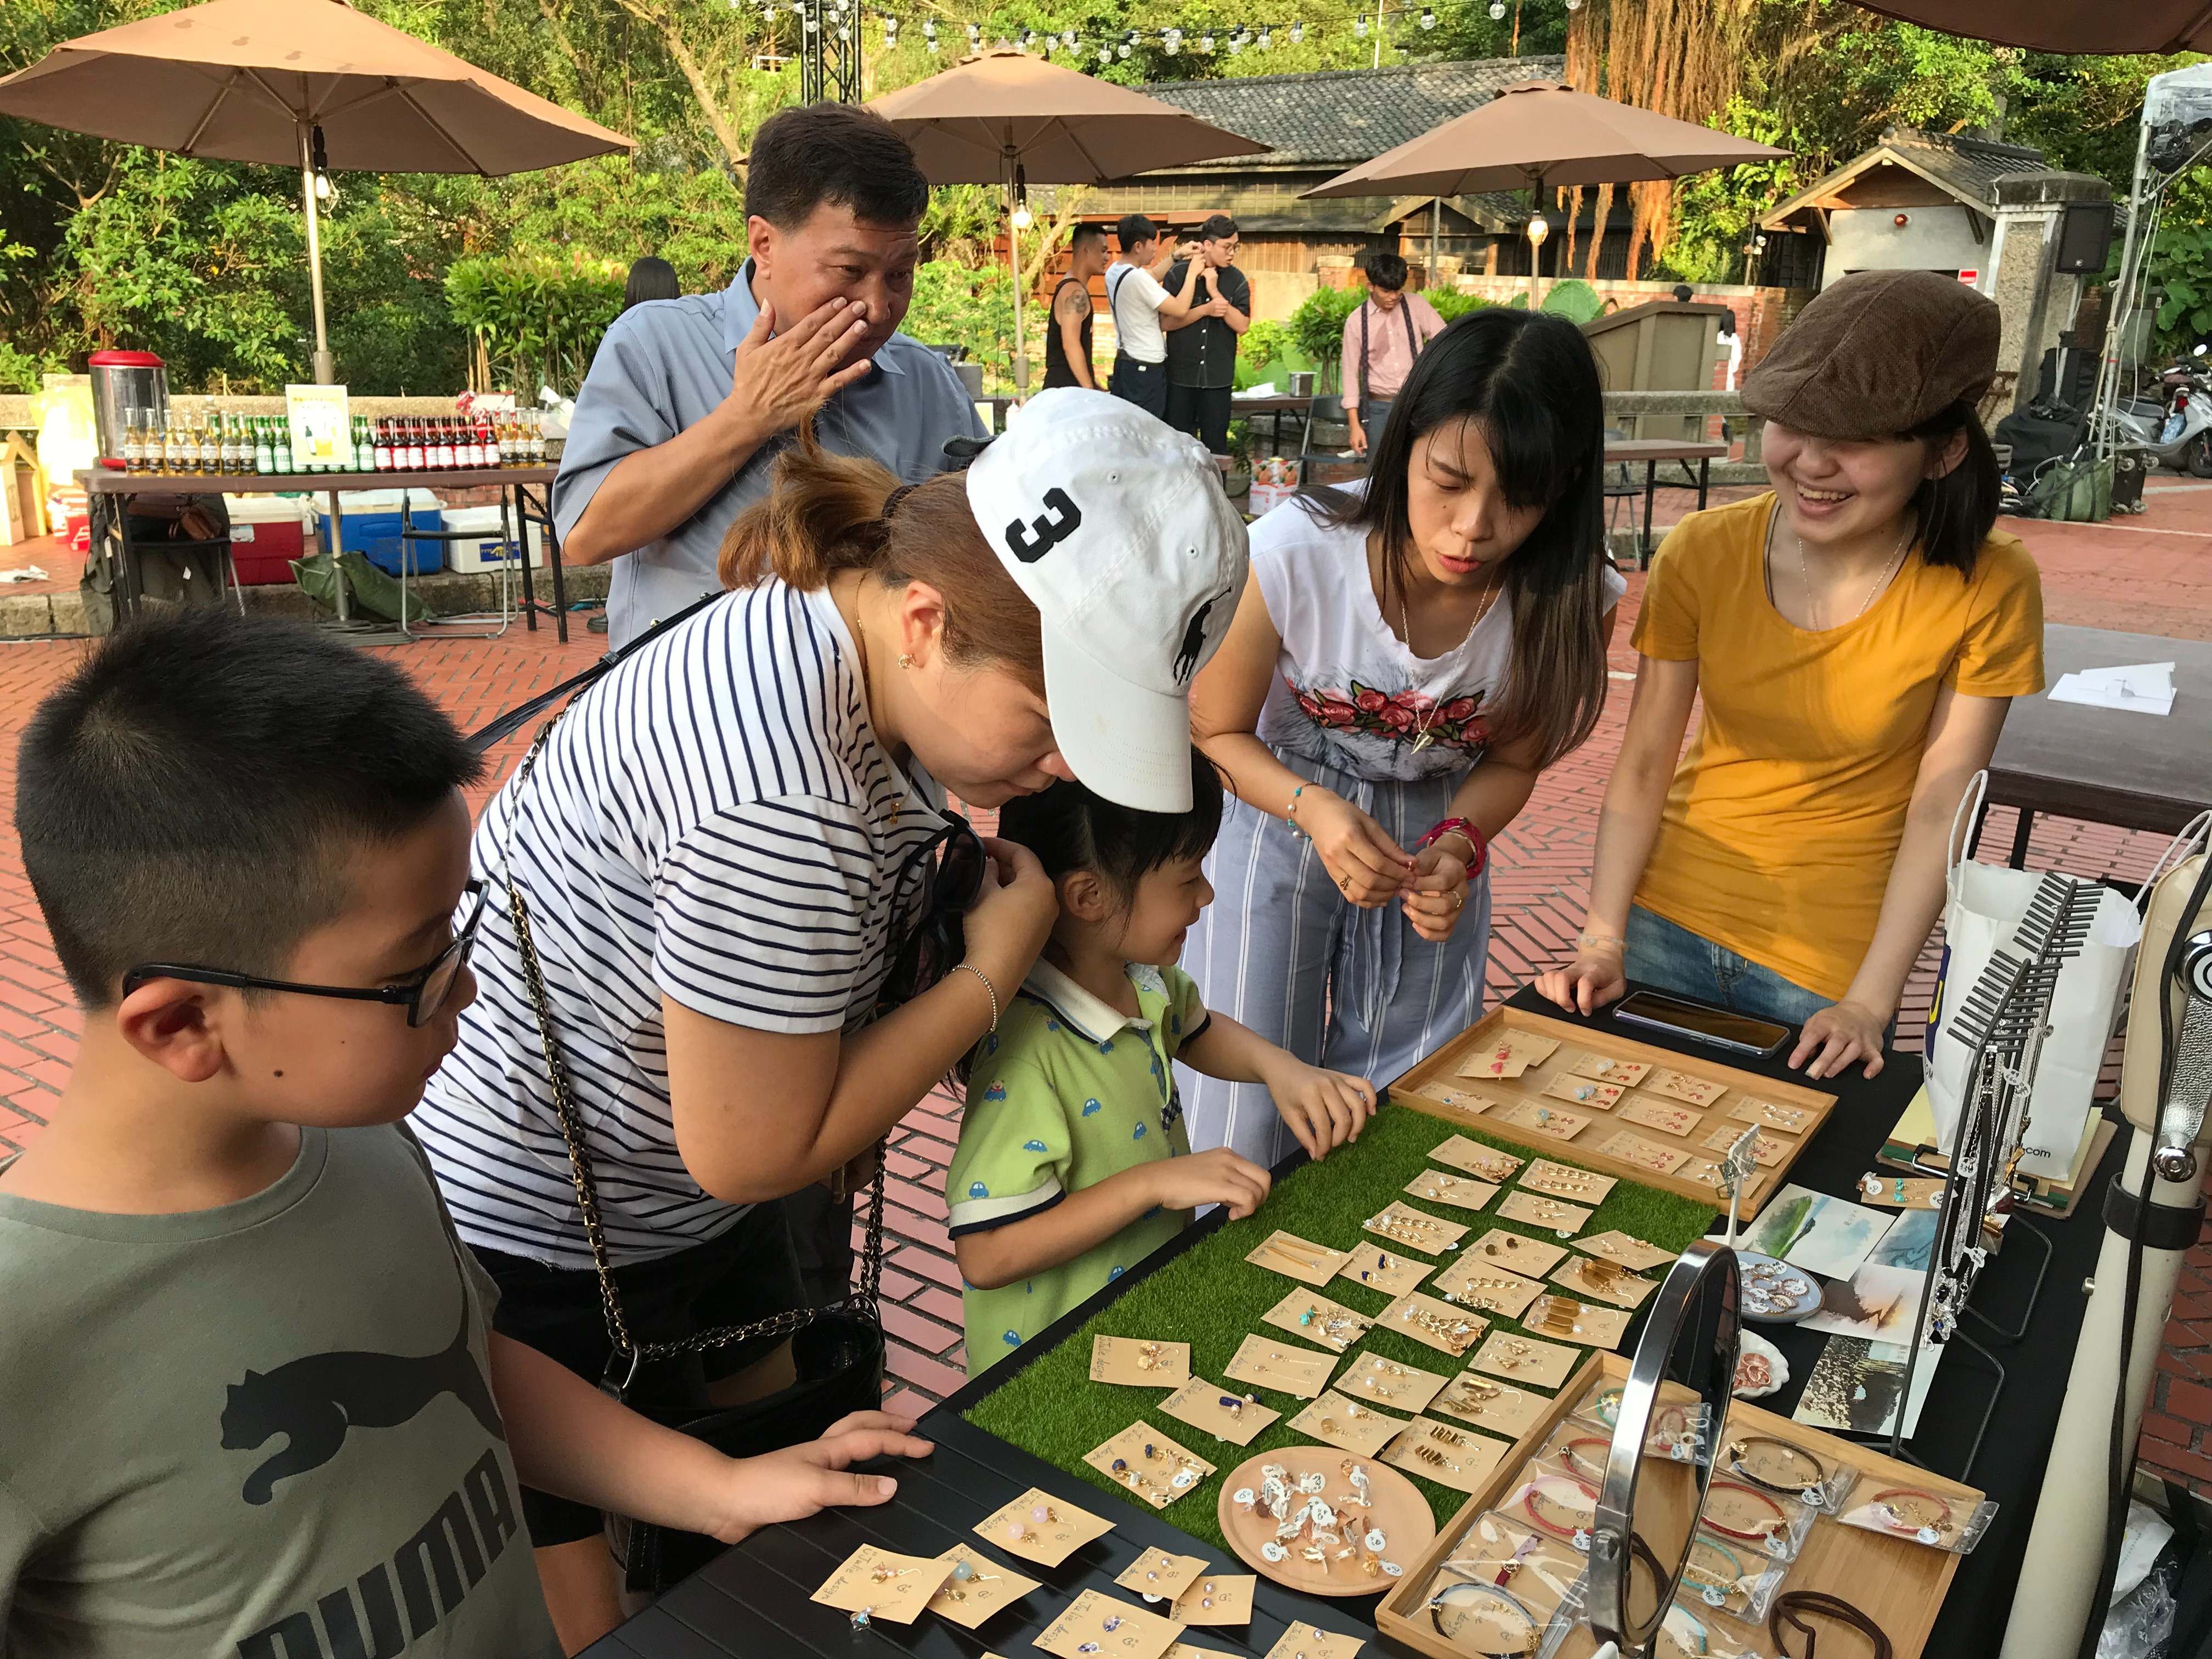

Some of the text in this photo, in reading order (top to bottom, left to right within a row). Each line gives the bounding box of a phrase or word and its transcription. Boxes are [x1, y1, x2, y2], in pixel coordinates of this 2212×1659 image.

[1006, 488, 1081, 562] 3
[979, 1495, 1035, 1533] Julie design
[821, 1554, 873, 1600] Julie design
[1040, 1600, 1092, 1647] Julie design
